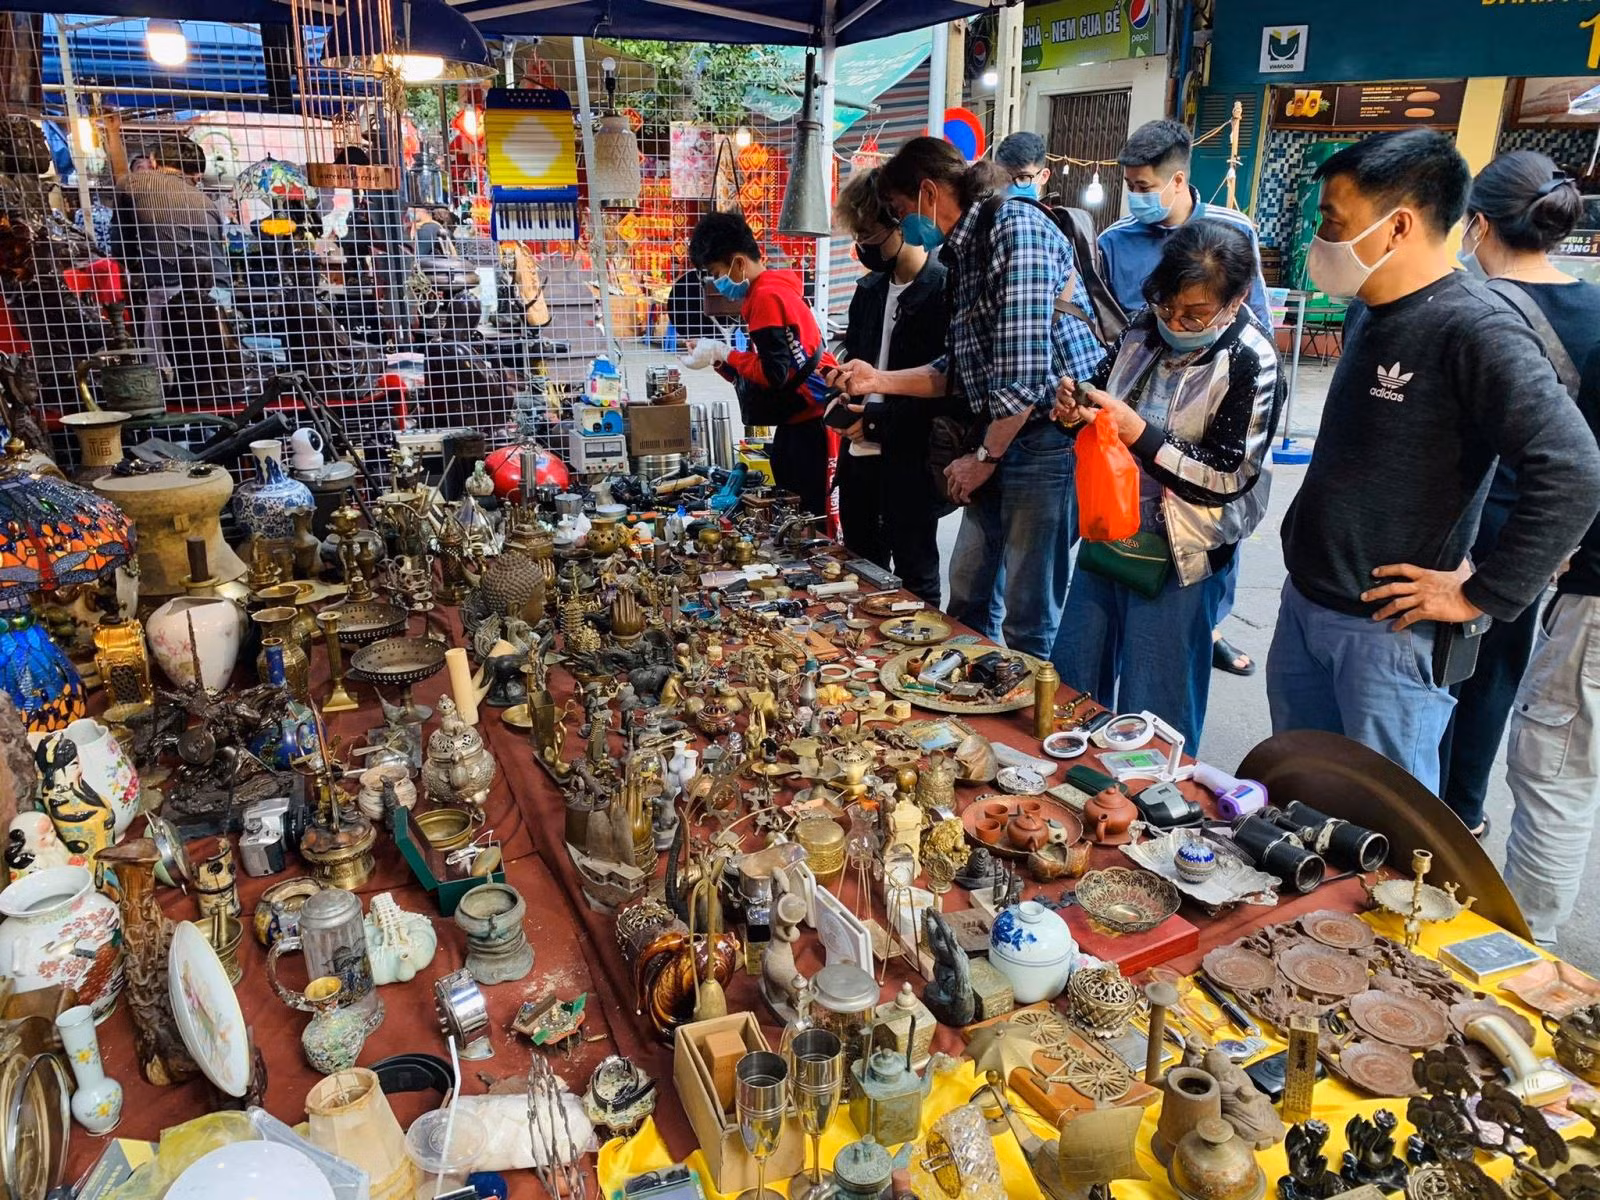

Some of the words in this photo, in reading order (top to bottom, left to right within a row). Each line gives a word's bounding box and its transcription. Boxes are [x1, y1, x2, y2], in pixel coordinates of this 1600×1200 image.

[1051, 18, 1076, 43] NEM
[1079, 13, 1102, 39] CUA
[1131, 32, 1149, 44] pepsi
[1369, 387, 1404, 402] adidas
[87, 437, 113, 457] 福
